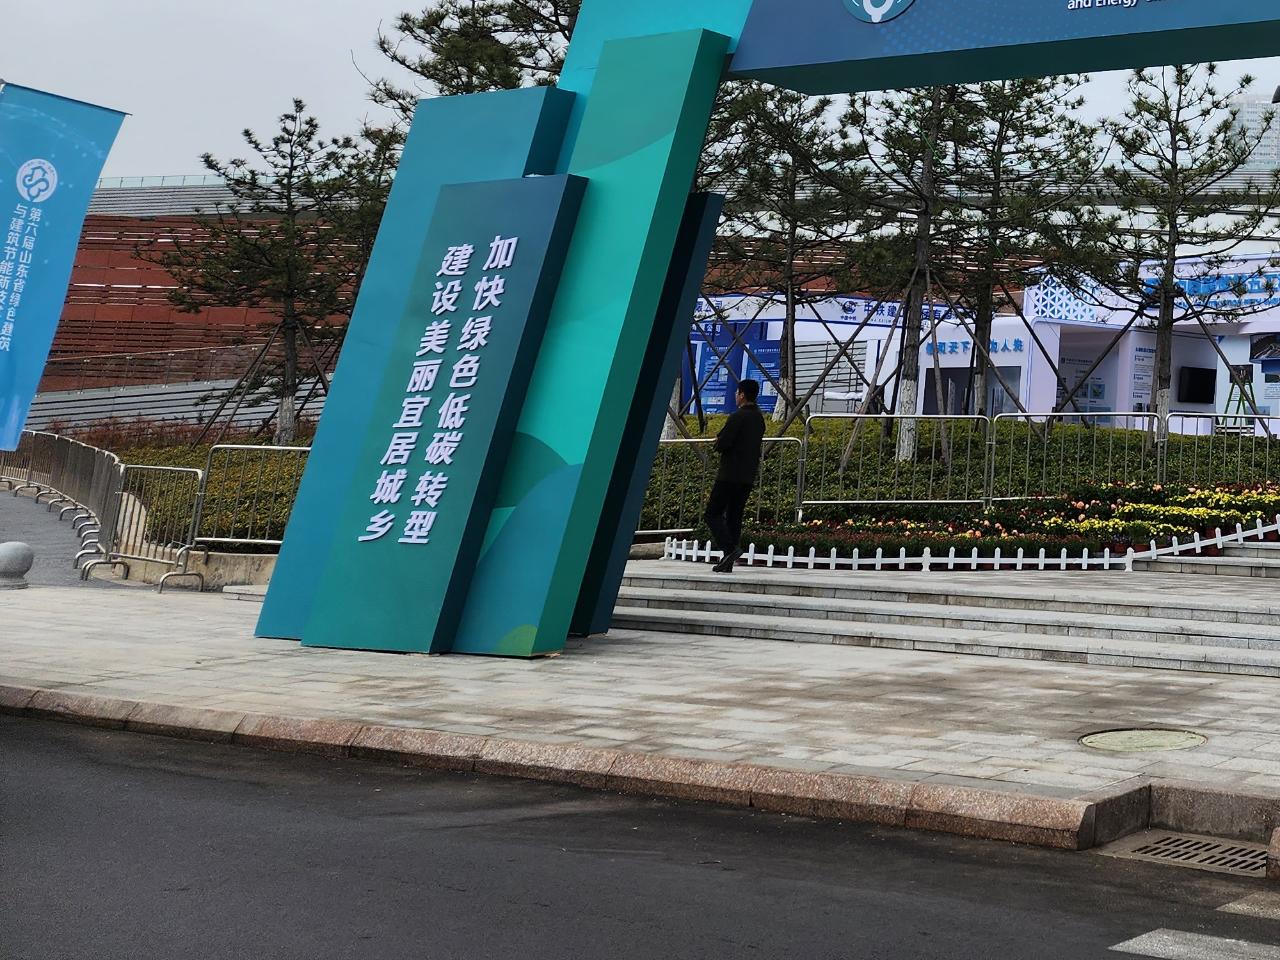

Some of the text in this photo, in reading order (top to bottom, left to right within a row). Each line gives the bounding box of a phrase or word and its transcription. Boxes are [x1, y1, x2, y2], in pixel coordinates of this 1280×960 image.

[0, 207, 41, 351] 第六届山东省绿色建筑
[358, 244, 474, 543] 建设美丽宜居城乡
[398, 235, 519, 545] 加快绿色低碳转型
